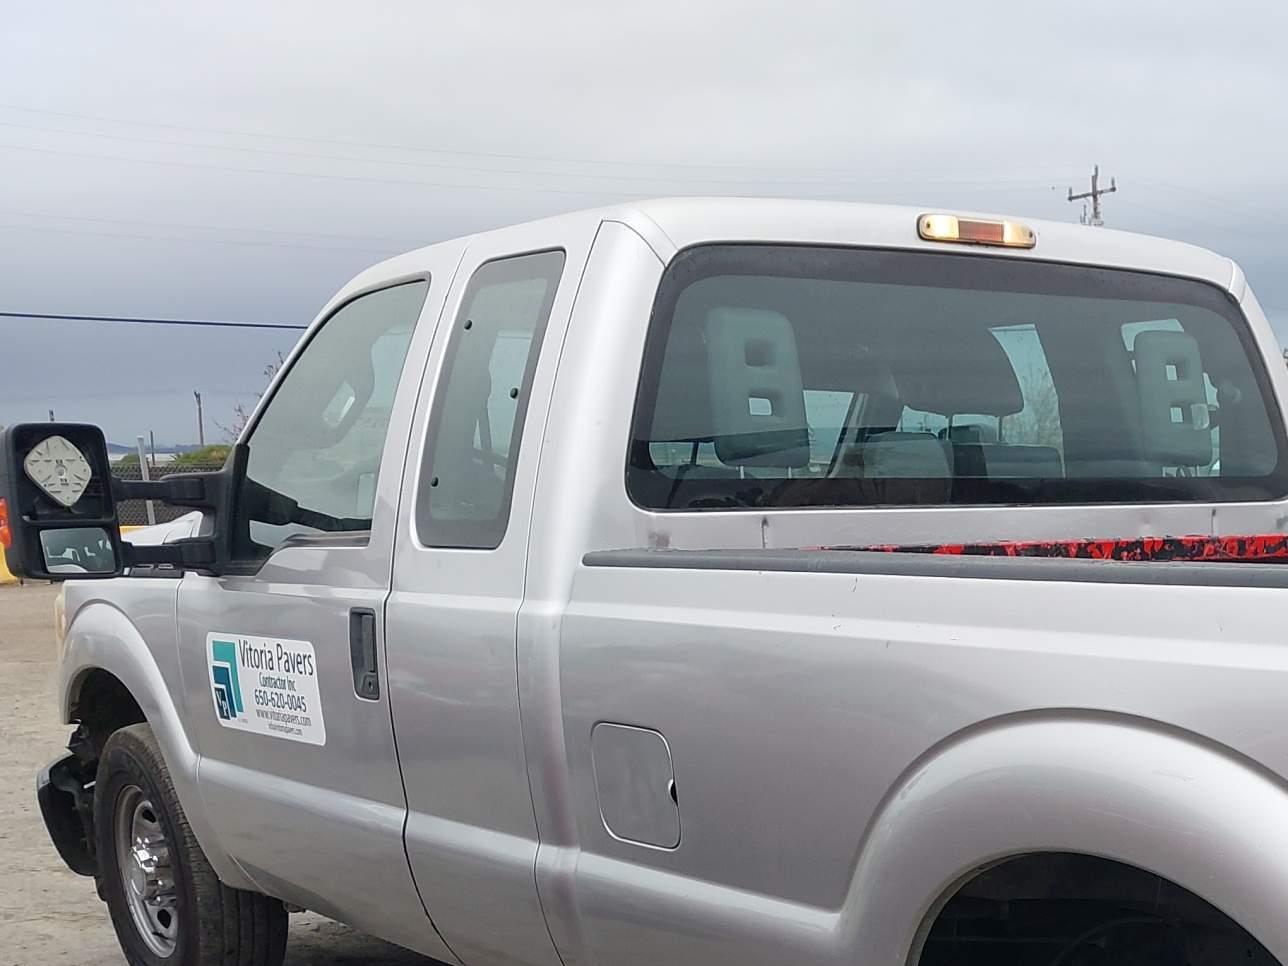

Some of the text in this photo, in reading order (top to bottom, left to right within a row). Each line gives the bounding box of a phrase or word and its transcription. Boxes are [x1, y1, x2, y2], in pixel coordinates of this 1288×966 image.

[238, 639, 314, 676] Vitoria Pavers
[254, 689, 307, 713] 650-620-0045
